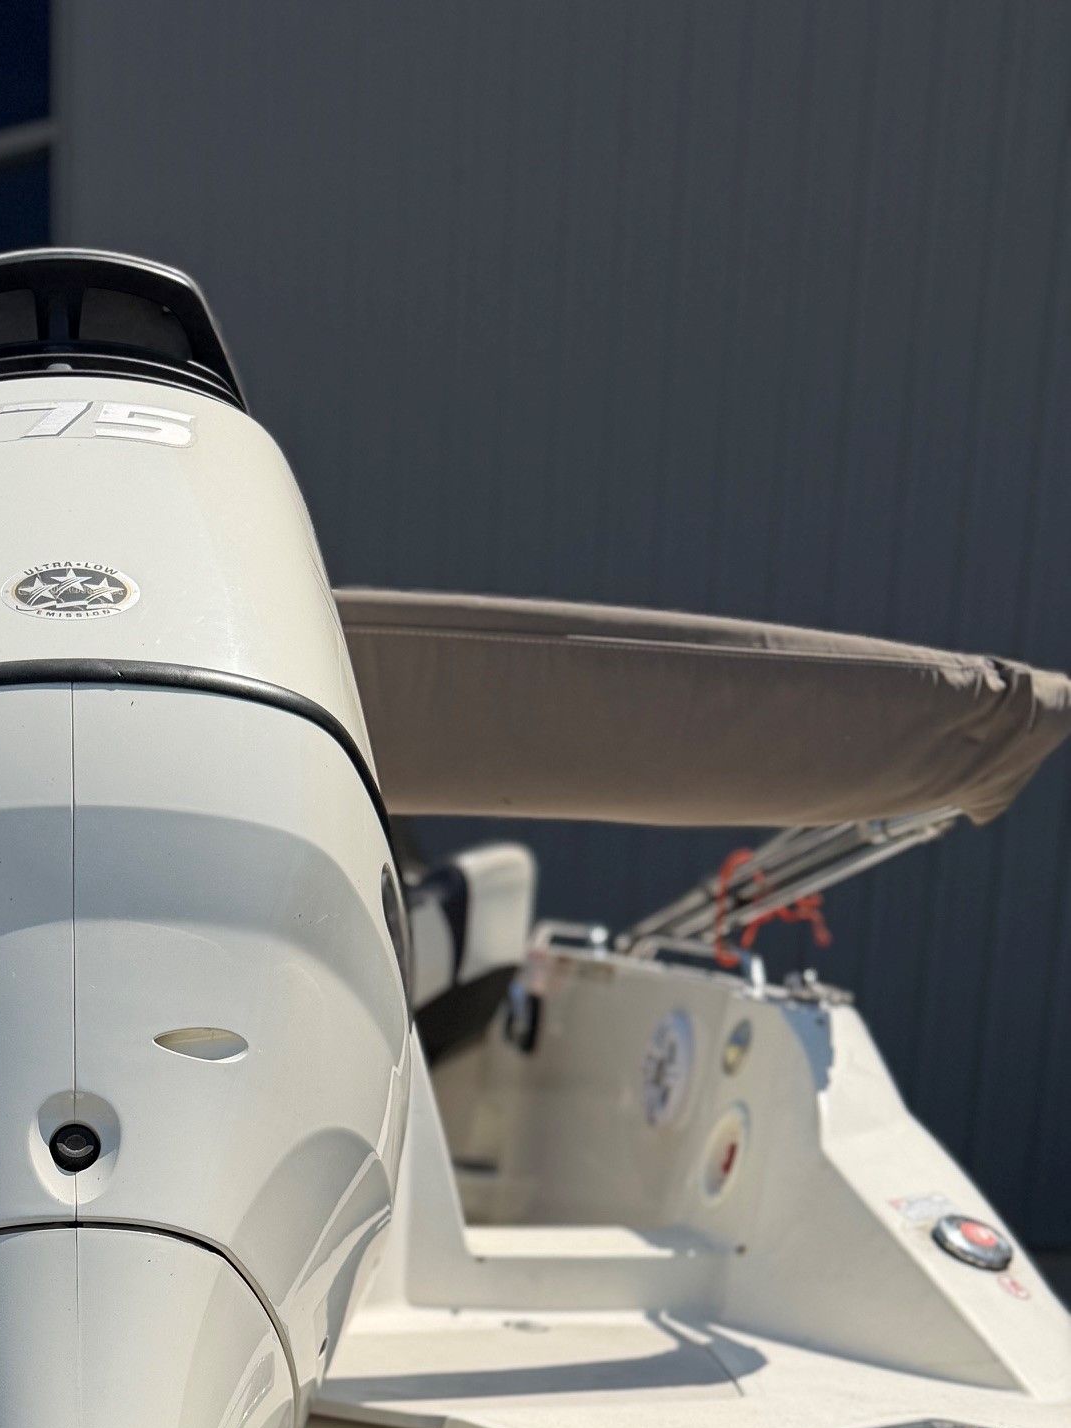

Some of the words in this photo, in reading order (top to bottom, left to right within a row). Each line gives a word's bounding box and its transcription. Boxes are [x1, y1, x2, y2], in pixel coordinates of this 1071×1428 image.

[23, 561, 73, 576] ULTRA
[84, 562, 119, 575] LOW
[36, 609, 111, 618] EMISSION
